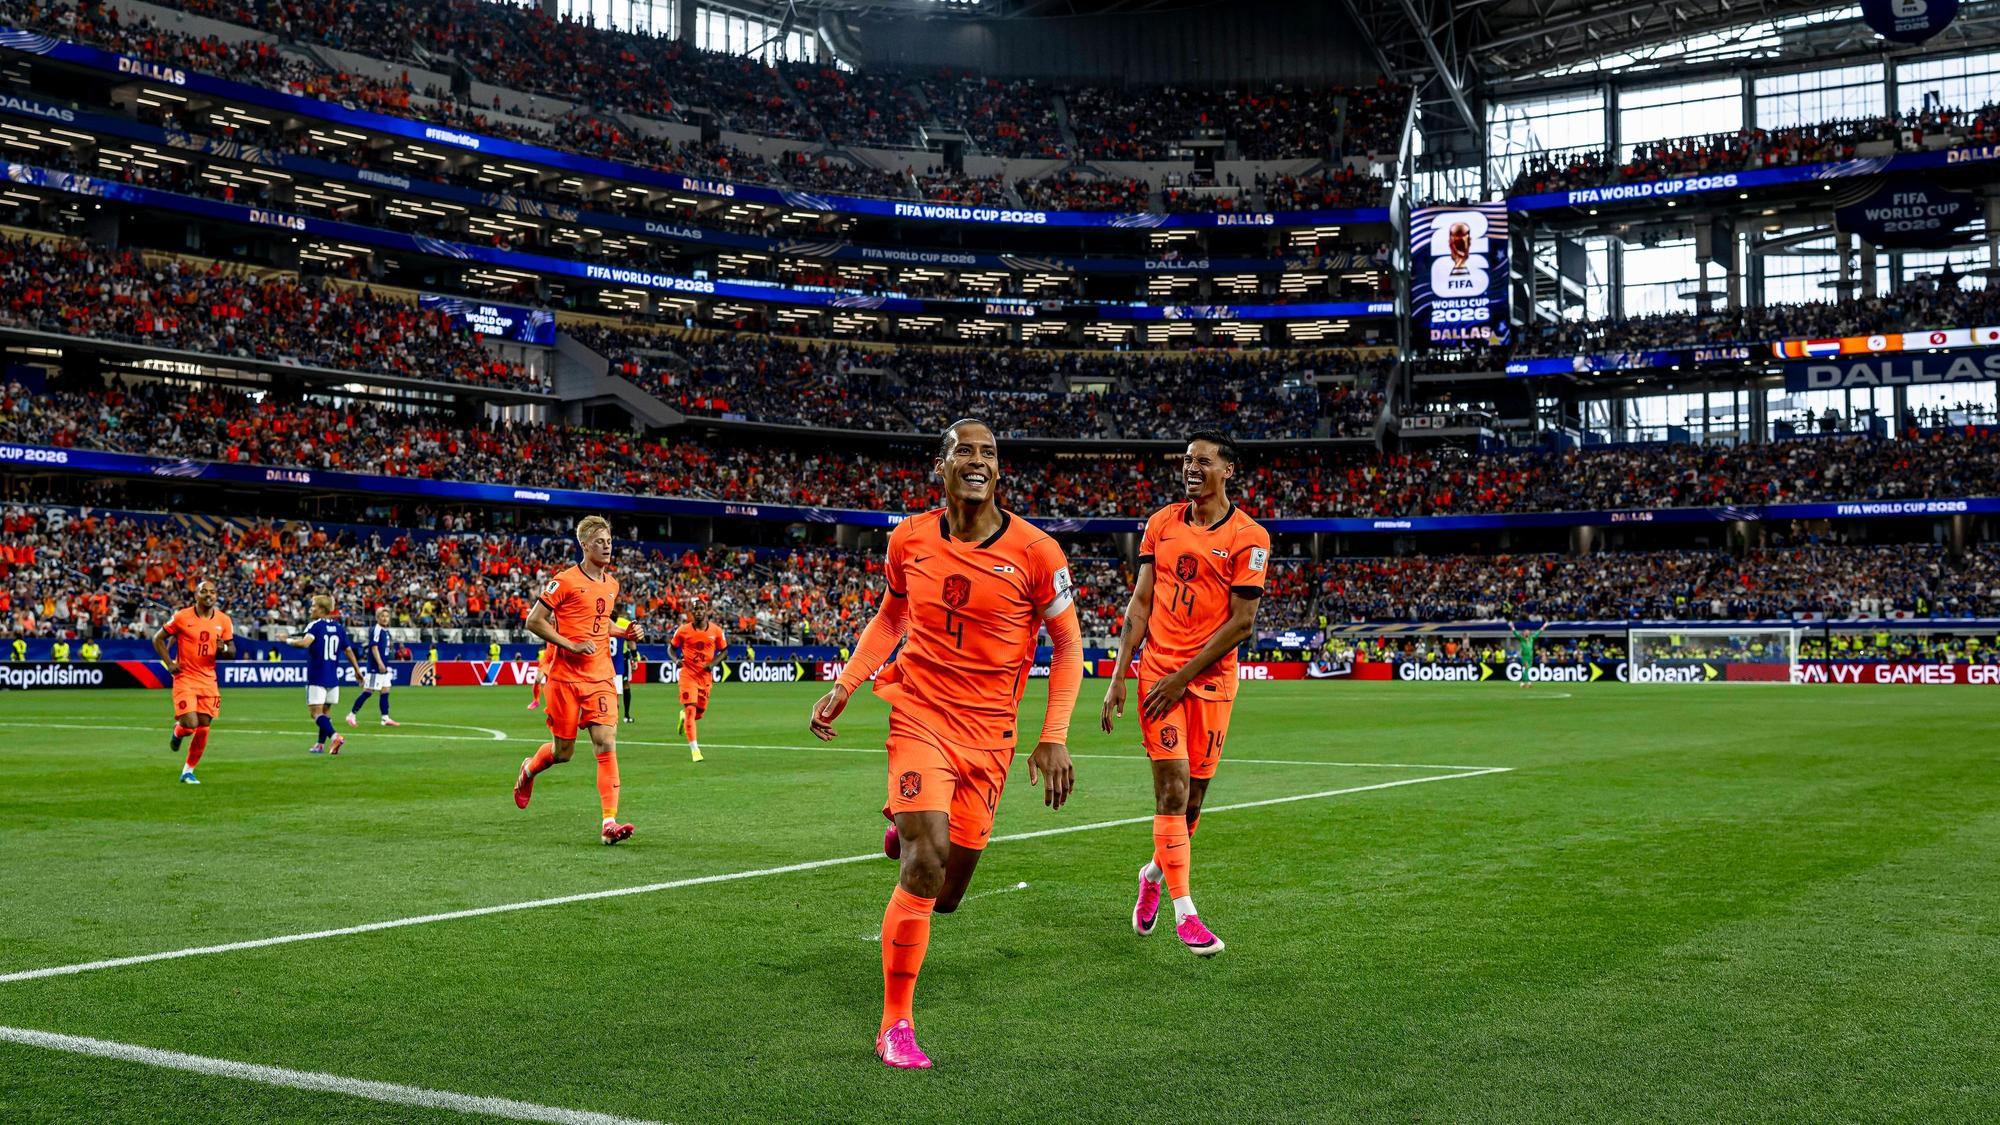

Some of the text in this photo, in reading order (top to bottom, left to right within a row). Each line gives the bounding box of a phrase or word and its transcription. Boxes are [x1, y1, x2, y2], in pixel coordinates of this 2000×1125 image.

[118, 57, 186, 85] DALLAS
[682, 178, 735, 196] DALLAS
[1568, 174, 1738, 204] FIFA WORLD CUP 2026
[1892, 192, 1928, 206] FIFA
[249, 209, 306, 231] DALLAS
[895, 203, 1047, 224] FIFA WORLD CUP 2026
[1217, 213, 1275, 226] DALLAS
[1865, 202, 1960, 221] WORLD CUP
[645, 222, 702, 239] DALLAS
[1884, 218, 1941, 233] 2026
[862, 248, 976, 264] FIFA WORLD CUP 2026
[1144, 260, 1210, 270] DALLAS
[587, 265, 715, 293] FIFA WORLD CUP 2026
[1448, 279, 1473, 289] FIFA
[985, 304, 1035, 317] DALLAS
[1431, 297, 1490, 309] WORLD CUP
[1431, 307, 1490, 323] 2026
[1430, 326, 1491, 341] DALLAS
[1694, 348, 1750, 361] DALLAS
[0, 446, 68, 464] CUP 2026
[266, 469, 311, 483] DALLAS
[725, 505, 759, 516] DALLAS
[1837, 500, 1967, 515] FIFA WORLD CUP 2026
[1611, 512, 1653, 522] DALLAS
[1170, 582, 1196, 617] 14
[592, 616, 600, 633] 6
[945, 609, 963, 649] 4
[197, 643, 209, 657] 18
[323, 634, 340, 660] 10
[224, 666, 258, 682] FIFA
[738, 661, 795, 682] Globant
[1400, 663, 1480, 681] Globant
[1506, 663, 1590, 681] Gobant
[1875, 664, 1956, 684] GAMES
[1967, 664, 2000, 684] GR
[598, 696, 608, 713] 6
[1206, 729, 1225, 758] 14
